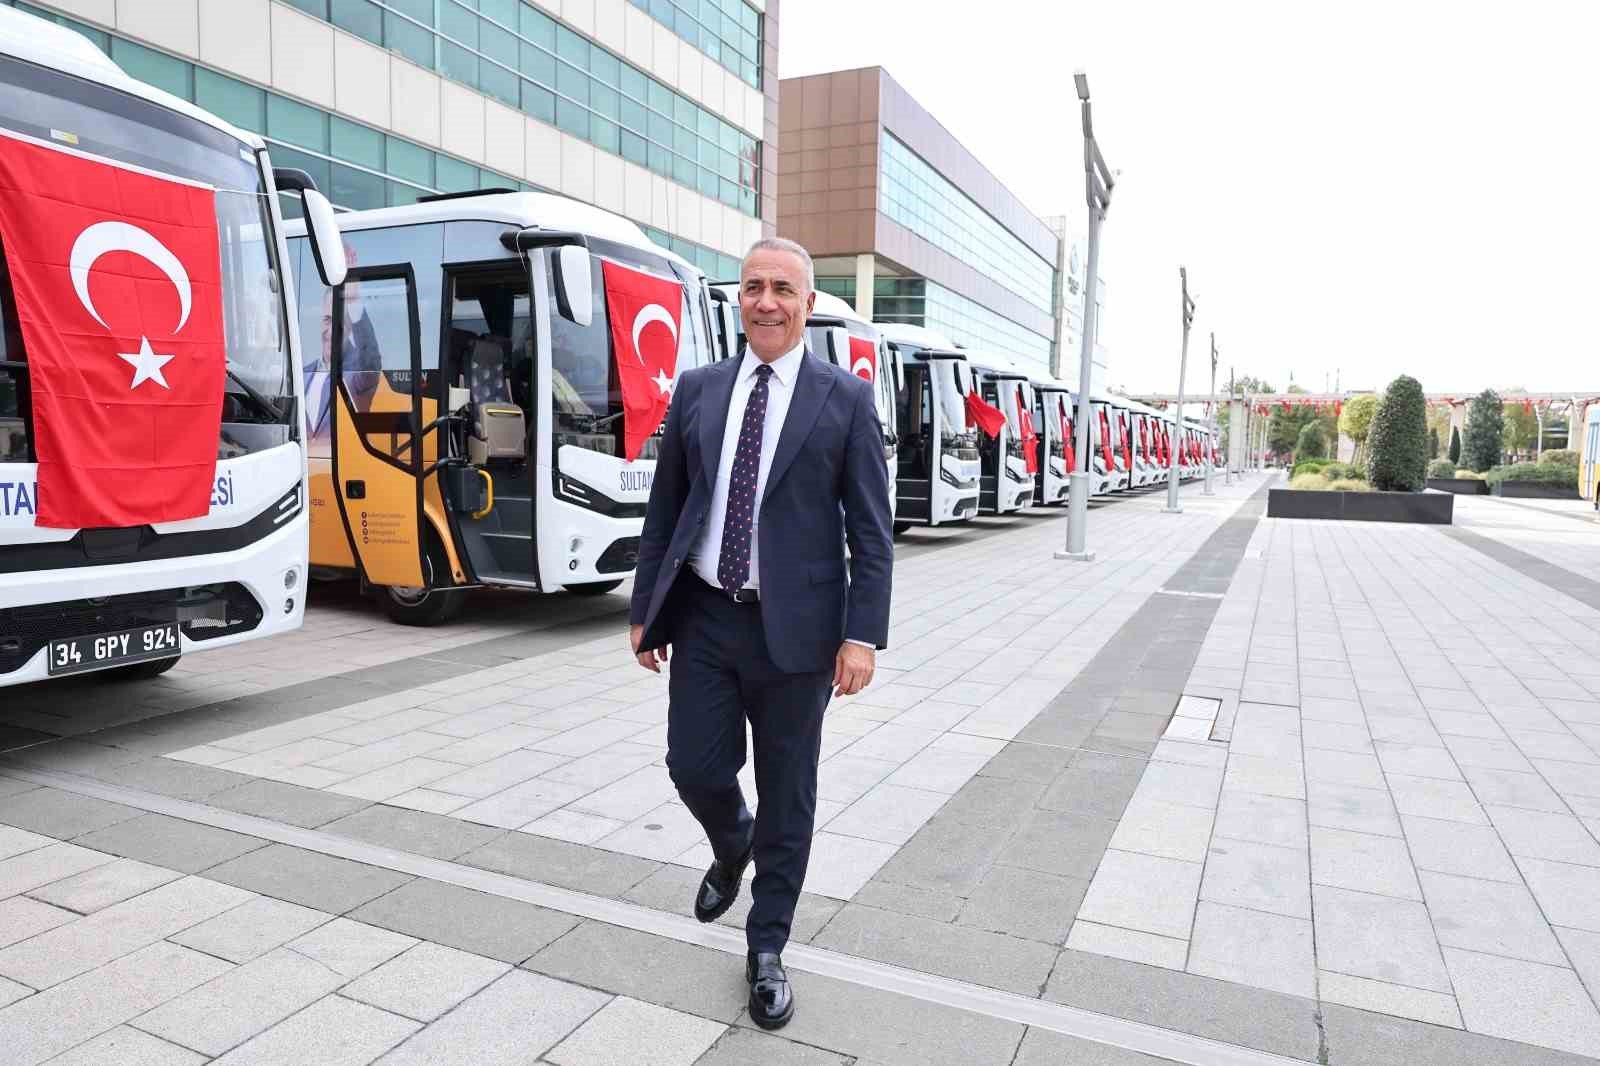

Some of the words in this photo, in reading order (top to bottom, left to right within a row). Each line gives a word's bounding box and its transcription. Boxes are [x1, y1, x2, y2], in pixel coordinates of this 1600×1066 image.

[391, 370, 429, 382] SULN
[56, 642, 82, 665] 34
[94, 634, 130, 659] GPY
[143, 627, 176, 651] 924
